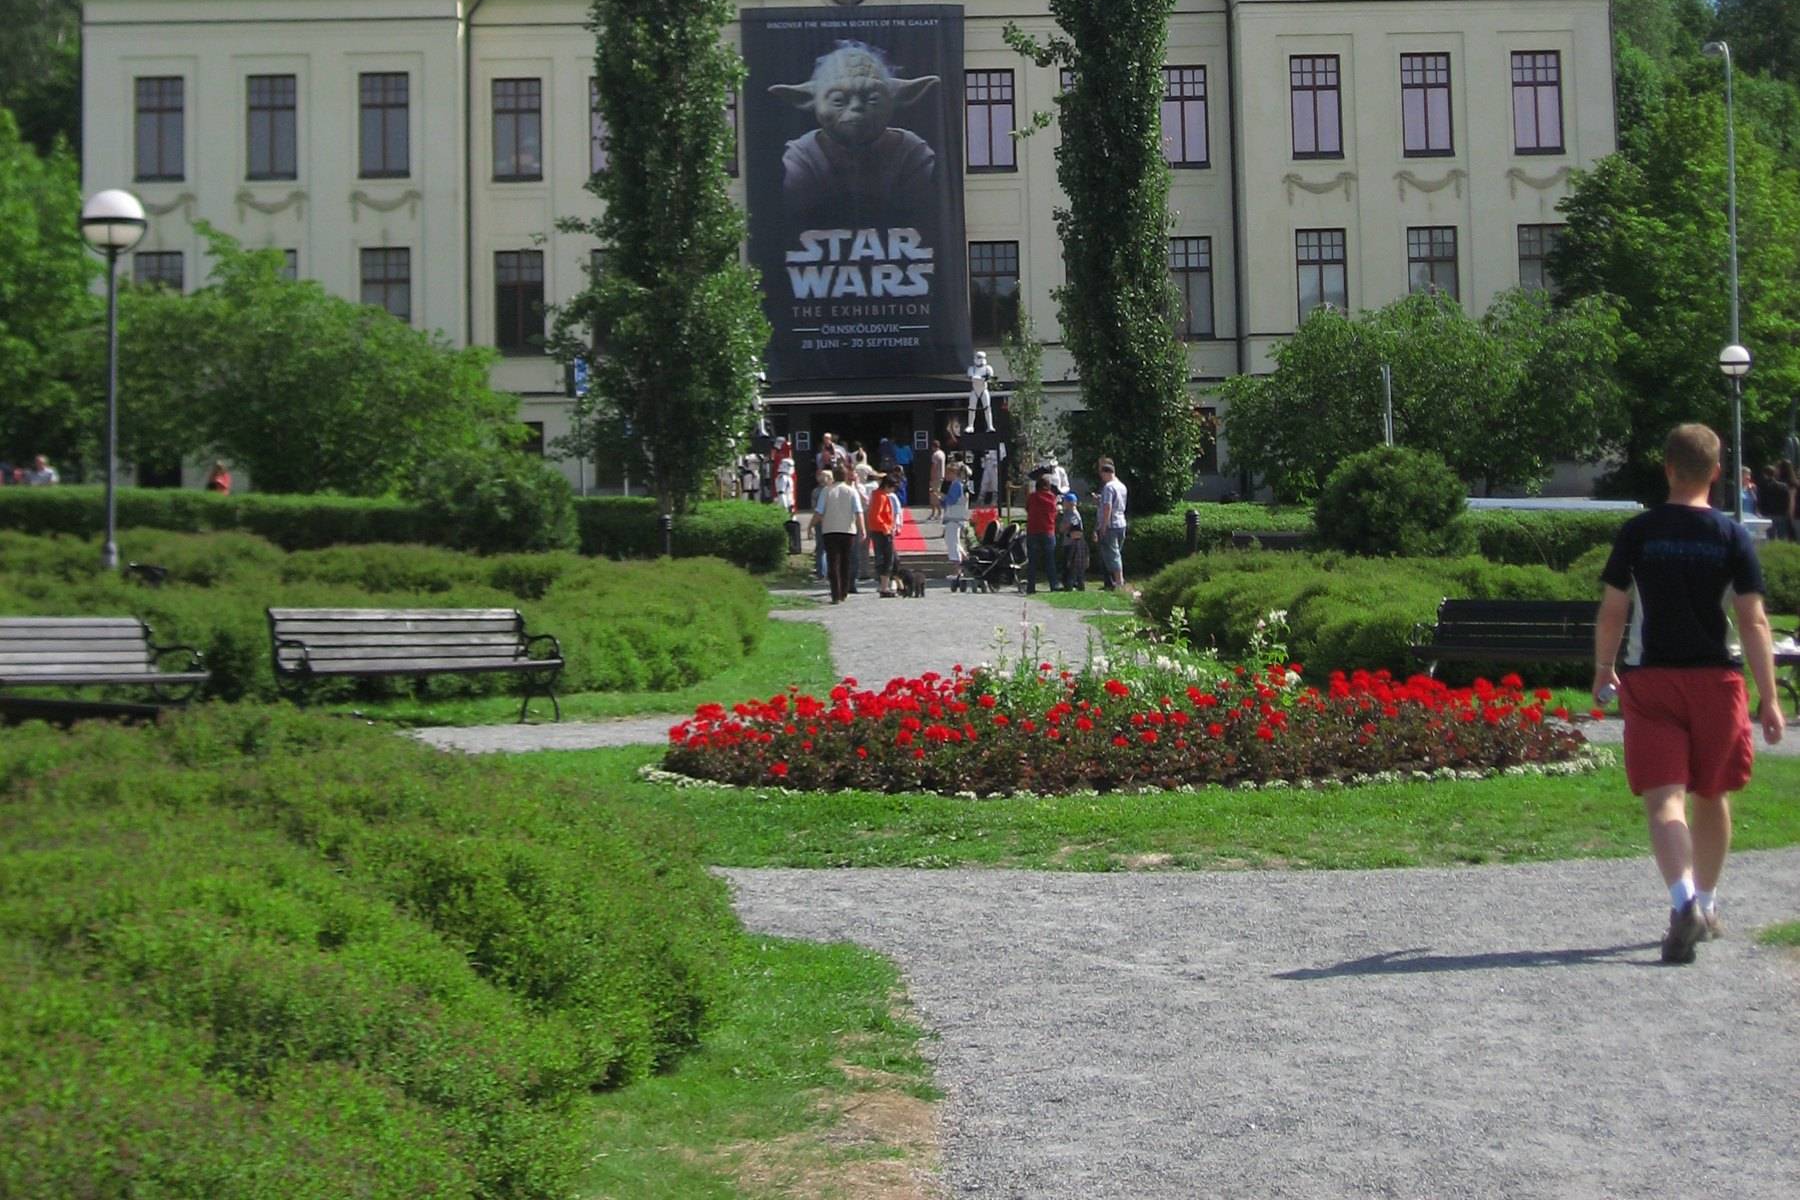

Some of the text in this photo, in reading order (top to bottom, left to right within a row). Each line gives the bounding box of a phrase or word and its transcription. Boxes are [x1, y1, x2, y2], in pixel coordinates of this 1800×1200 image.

[804, 20, 818, 28] THE
[850, 19, 879, 28] SECRETS
[880, 19, 892, 27] OF
[893, 19, 906, 27] THE
[908, 19, 939, 27] GALAXY
[785, 227, 934, 263] STAR
[786, 263, 935, 299] WARS
[792, 304, 931, 318] THE EXHIBITION
[820, 322, 900, 335] ÖRNSKÖLDSVIK
[816, 339, 840, 350] JUNI
[851, 338, 864, 348] 30
[866, 337, 920, 348] SEPTEMBER
